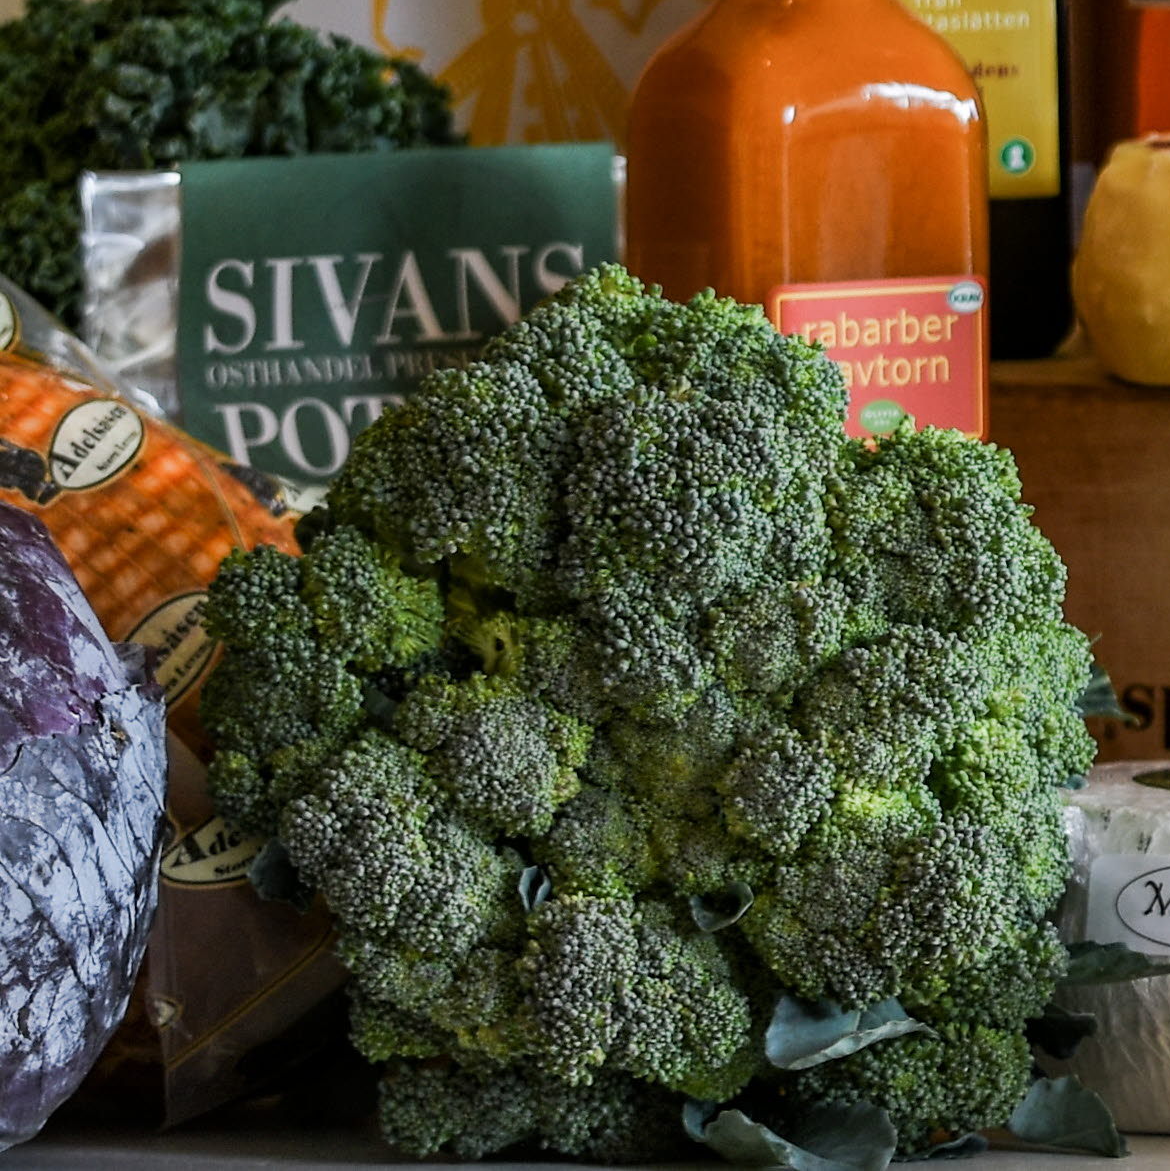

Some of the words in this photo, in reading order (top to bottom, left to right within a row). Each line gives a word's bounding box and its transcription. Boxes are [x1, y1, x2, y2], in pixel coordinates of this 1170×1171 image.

[204, 241, 585, 354] SIVANS
[803, 308, 959, 349] rabarber
[205, 354, 379, 389] OSTHANDEL
[840, 354, 951, 390] avtorn
